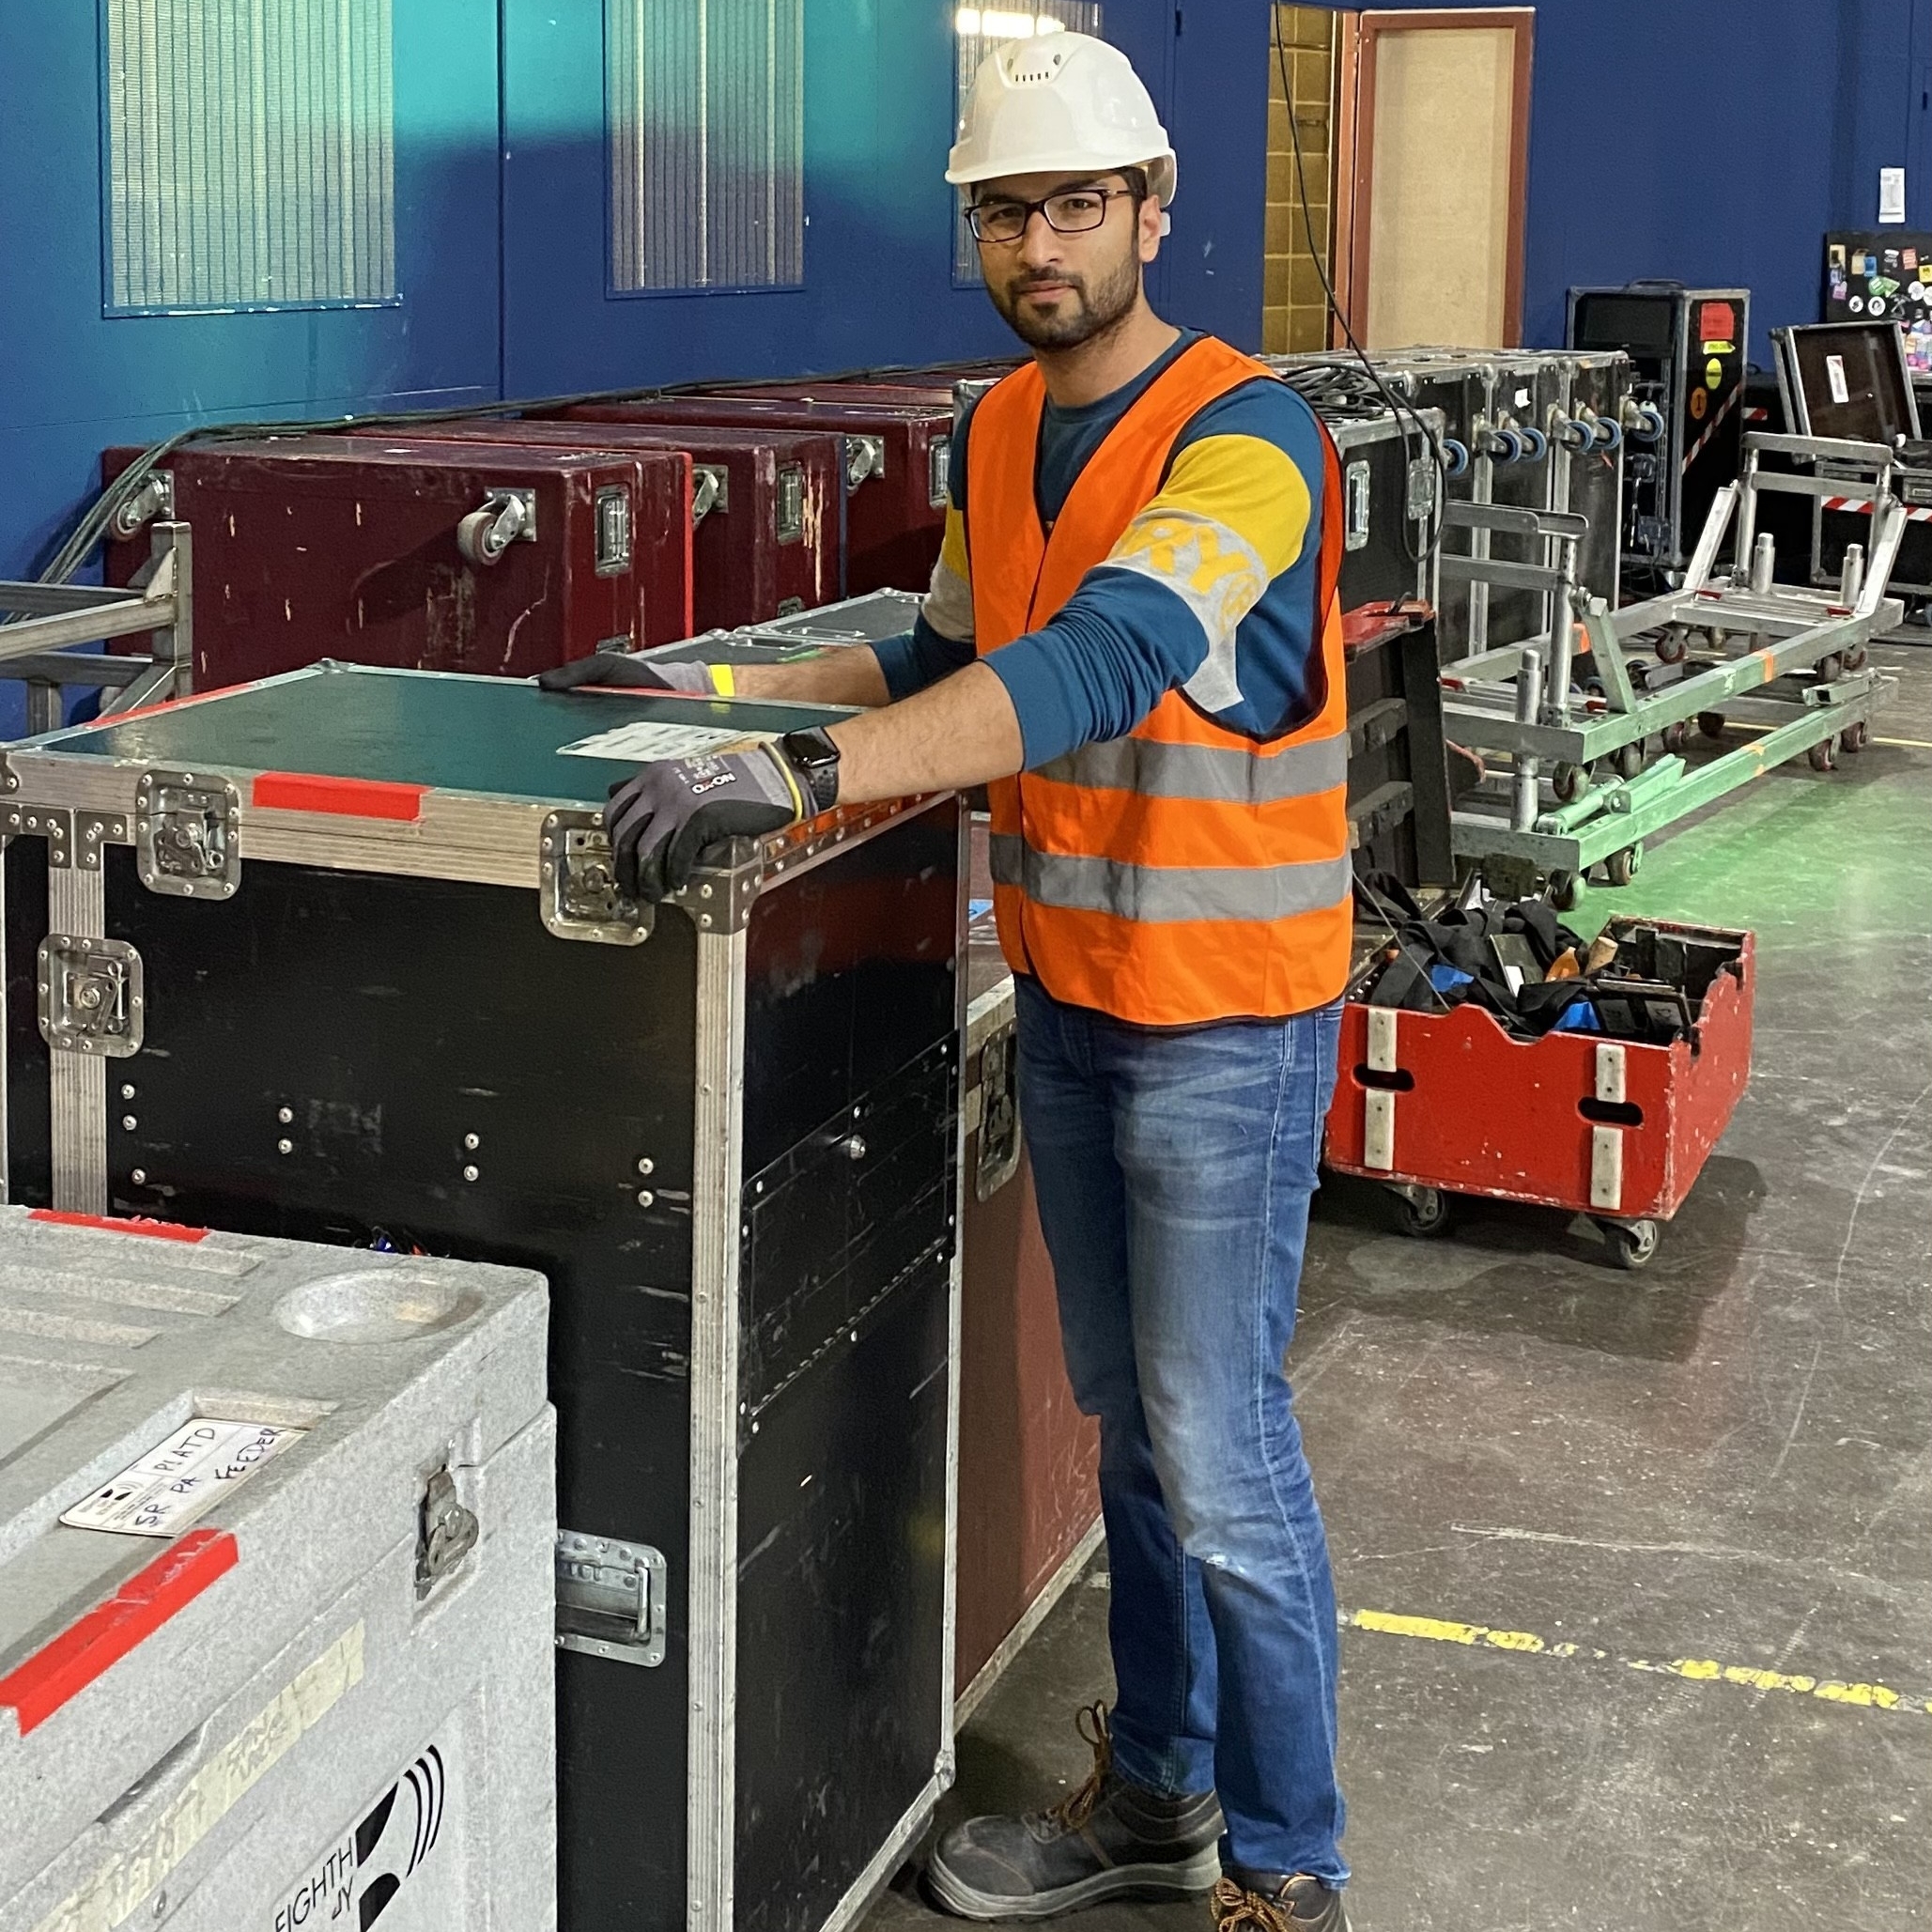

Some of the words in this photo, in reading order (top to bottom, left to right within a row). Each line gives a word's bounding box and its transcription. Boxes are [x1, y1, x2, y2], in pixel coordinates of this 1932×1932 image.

[134, 1504, 171, 1527] SR
[170, 1476, 202, 1493] PA
[214, 1428, 286, 1479] FEEDER
